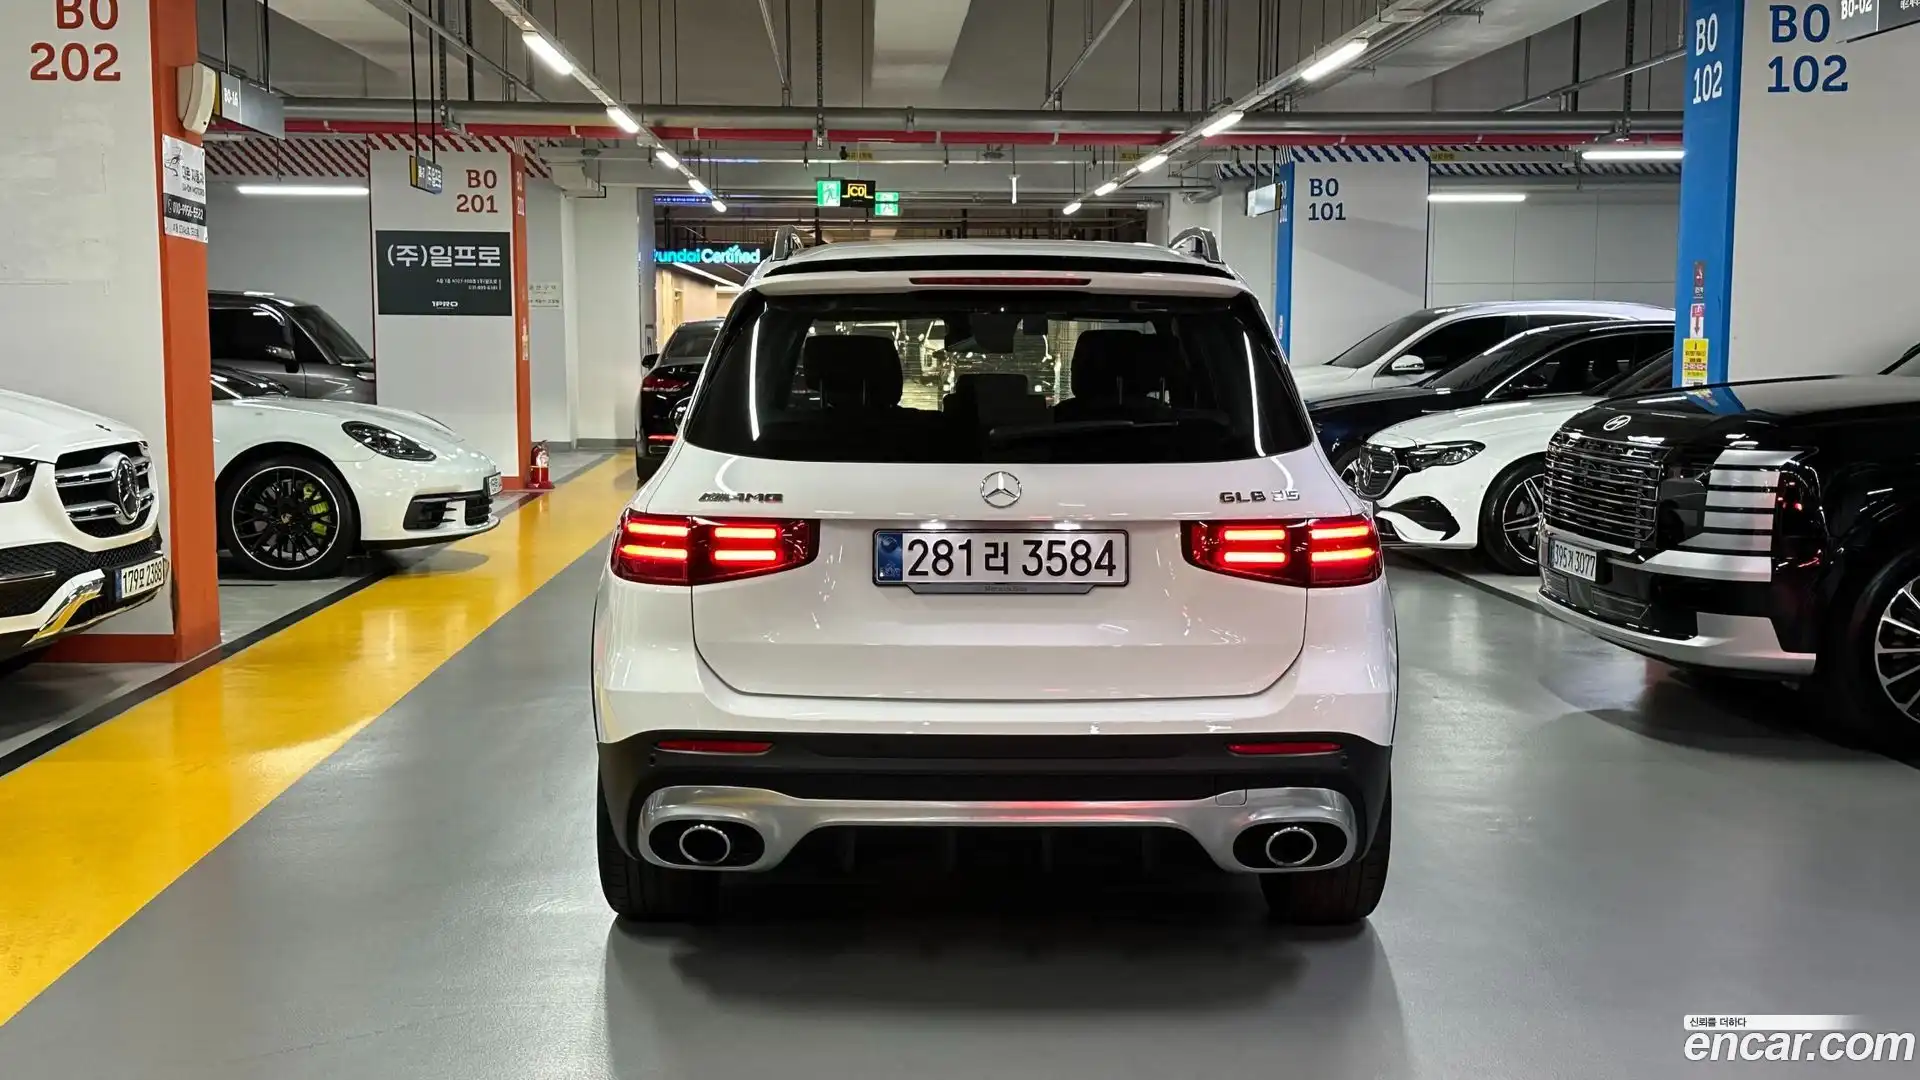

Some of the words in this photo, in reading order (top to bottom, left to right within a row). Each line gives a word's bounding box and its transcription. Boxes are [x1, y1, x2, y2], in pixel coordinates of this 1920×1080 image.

[30, 42, 121, 81] 202
[1693, 61, 1723, 104] 102
[1767, 55, 1848, 93] 102
[456, 194, 498, 213] 201
[1308, 202, 1346, 221] 101
[387, 244, 501, 267] (주)일프로
[701, 245, 760, 263] Certified
[1219, 491, 1267, 503] GLB
[1021, 539, 1117, 577] 3584
